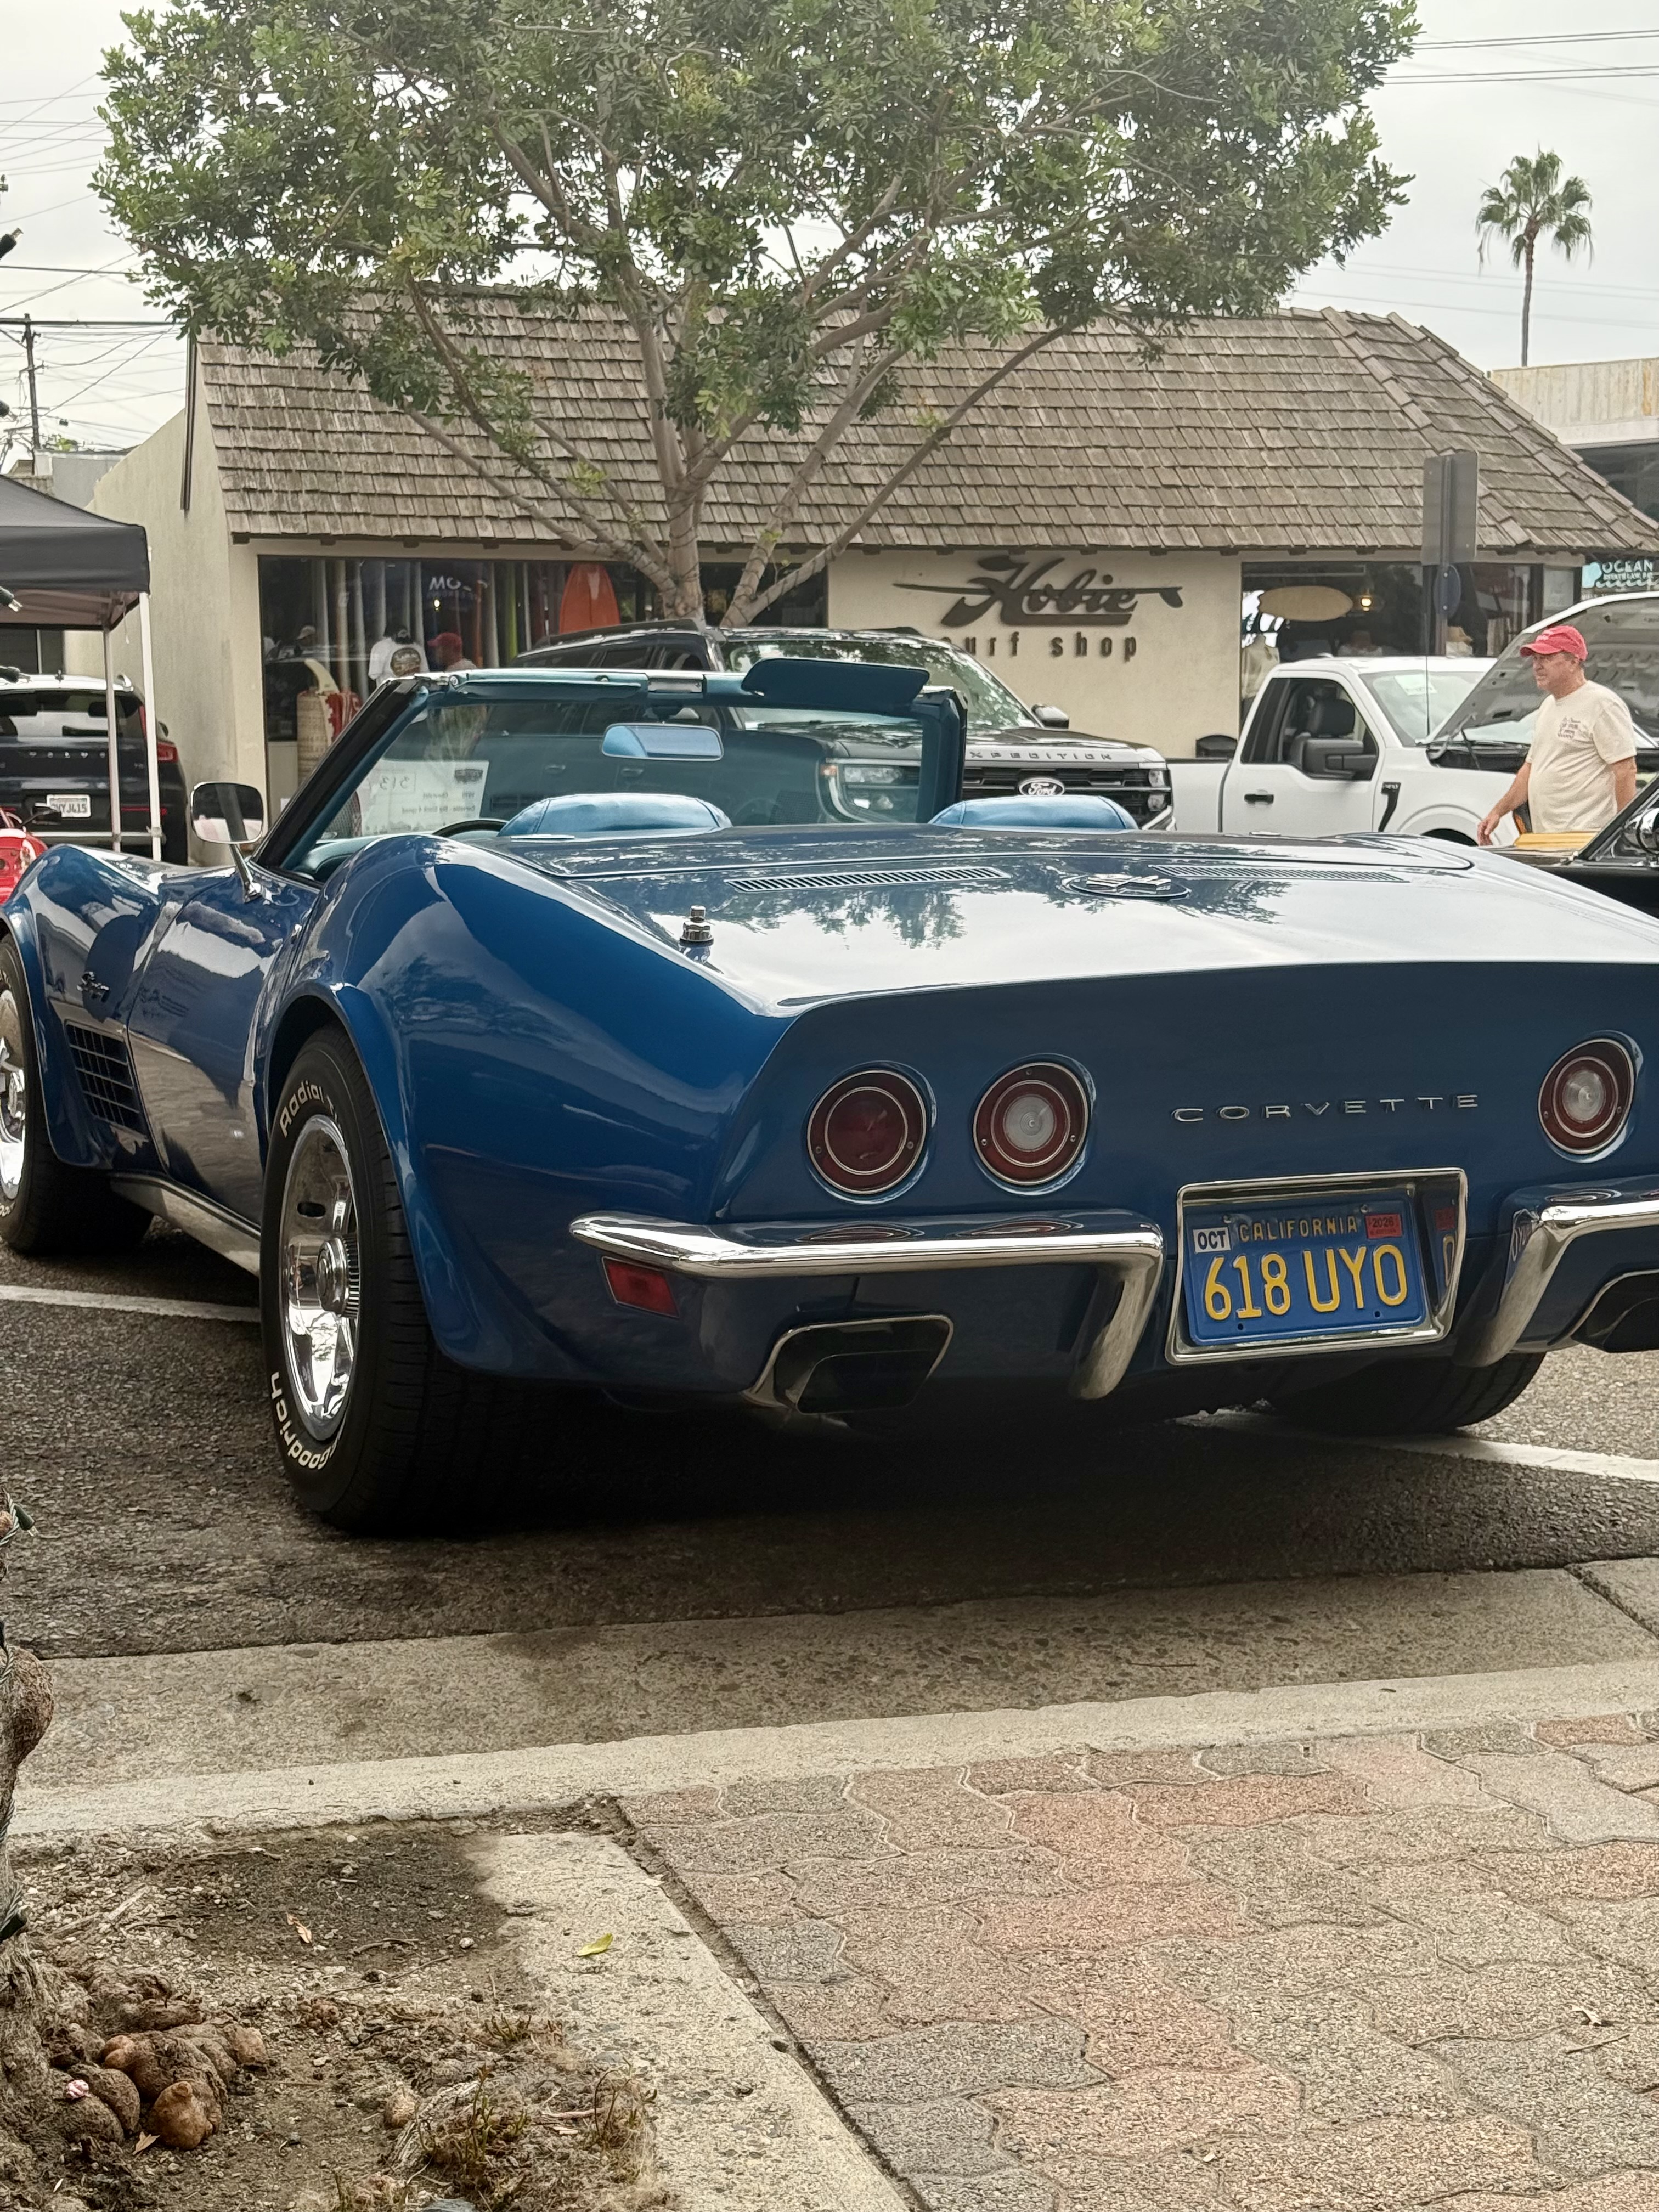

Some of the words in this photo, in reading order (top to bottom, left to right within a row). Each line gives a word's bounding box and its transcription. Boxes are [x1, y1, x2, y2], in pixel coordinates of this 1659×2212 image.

[1601, 559, 1654, 573] OCEAN
[940, 555, 1139, 626] Hobie
[1051, 631, 1136, 662] shop
[969, 752, 1113, 760] XPEDITION
[1028, 782, 1057, 796] Ford
[280, 1080, 324, 1138] Radial
[1172, 1094, 1478, 1122] CORVETTE
[1239, 1216, 1358, 1242] CALIFORNIA
[1373, 1217, 1394, 1228] 2026
[1197, 1231, 1226, 1250] OCT
[1204, 1252, 1291, 1321] 618
[1302, 1243, 1408, 1312] UYO
